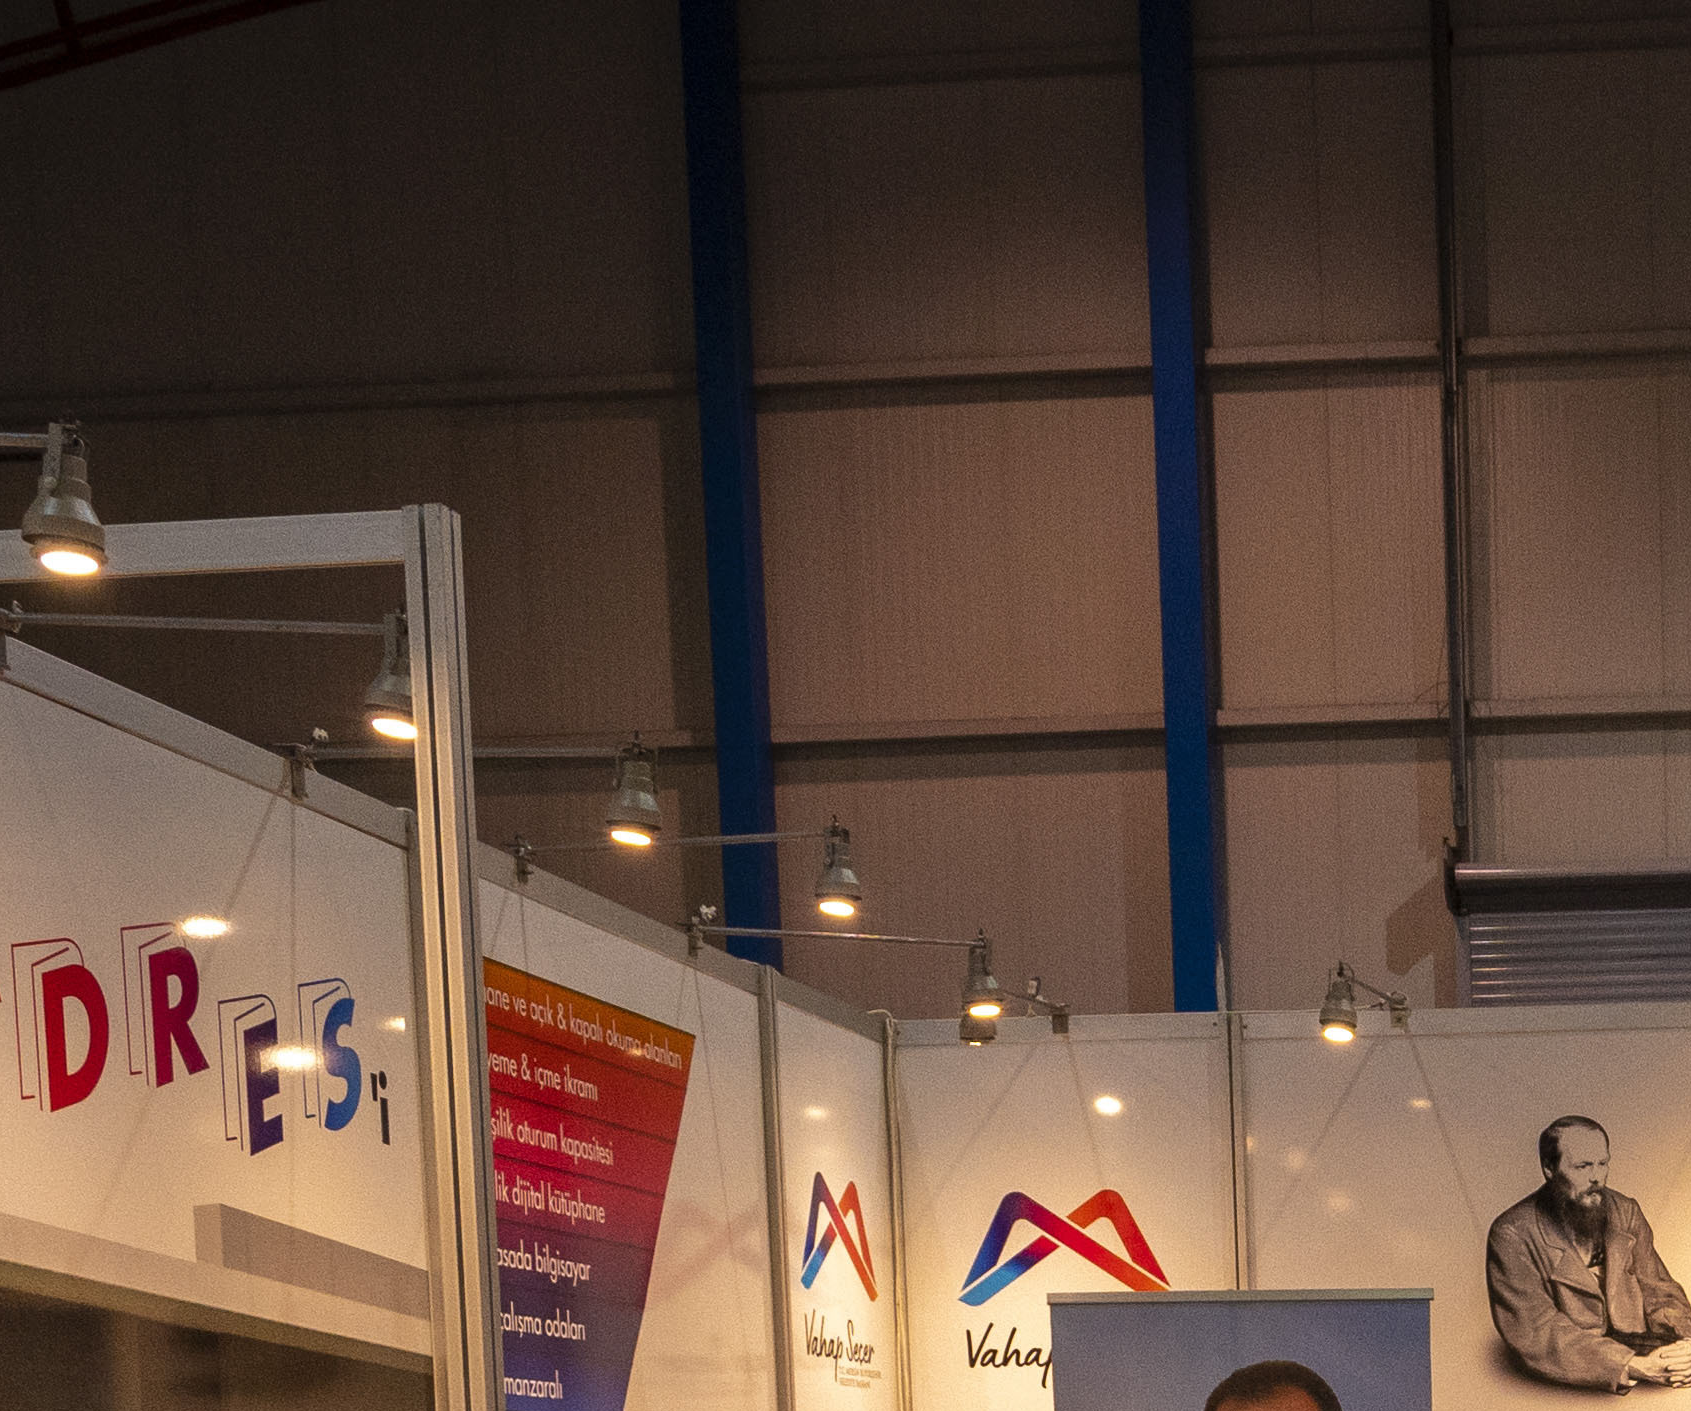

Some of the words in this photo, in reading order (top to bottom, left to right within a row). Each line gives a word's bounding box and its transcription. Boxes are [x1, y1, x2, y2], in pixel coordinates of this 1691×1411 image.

[513, 996, 527, 1016] ve
[530, 995, 553, 1028] açık
[557, 1003, 567, 1030] &
[569, 1003, 603, 1045] kapalı
[521, 1053, 531, 1081] &
[534, 1058, 561, 1090] içme
[564, 1064, 598, 1101] ikramı
[517, 1121, 558, 1151] oturum
[560, 1124, 614, 1165] kapasitesi
[512, 1175, 545, 1215] dijital
[548, 1182, 606, 1226] kütüphane
[535, 1242, 591, 1287] bilgisayar
[545, 1308, 586, 1341] odaları
[804, 1310, 843, 1382] Vahap
[845, 1319, 875, 1365] Seçer
[504, 1370, 563, 1400] manzaralı
